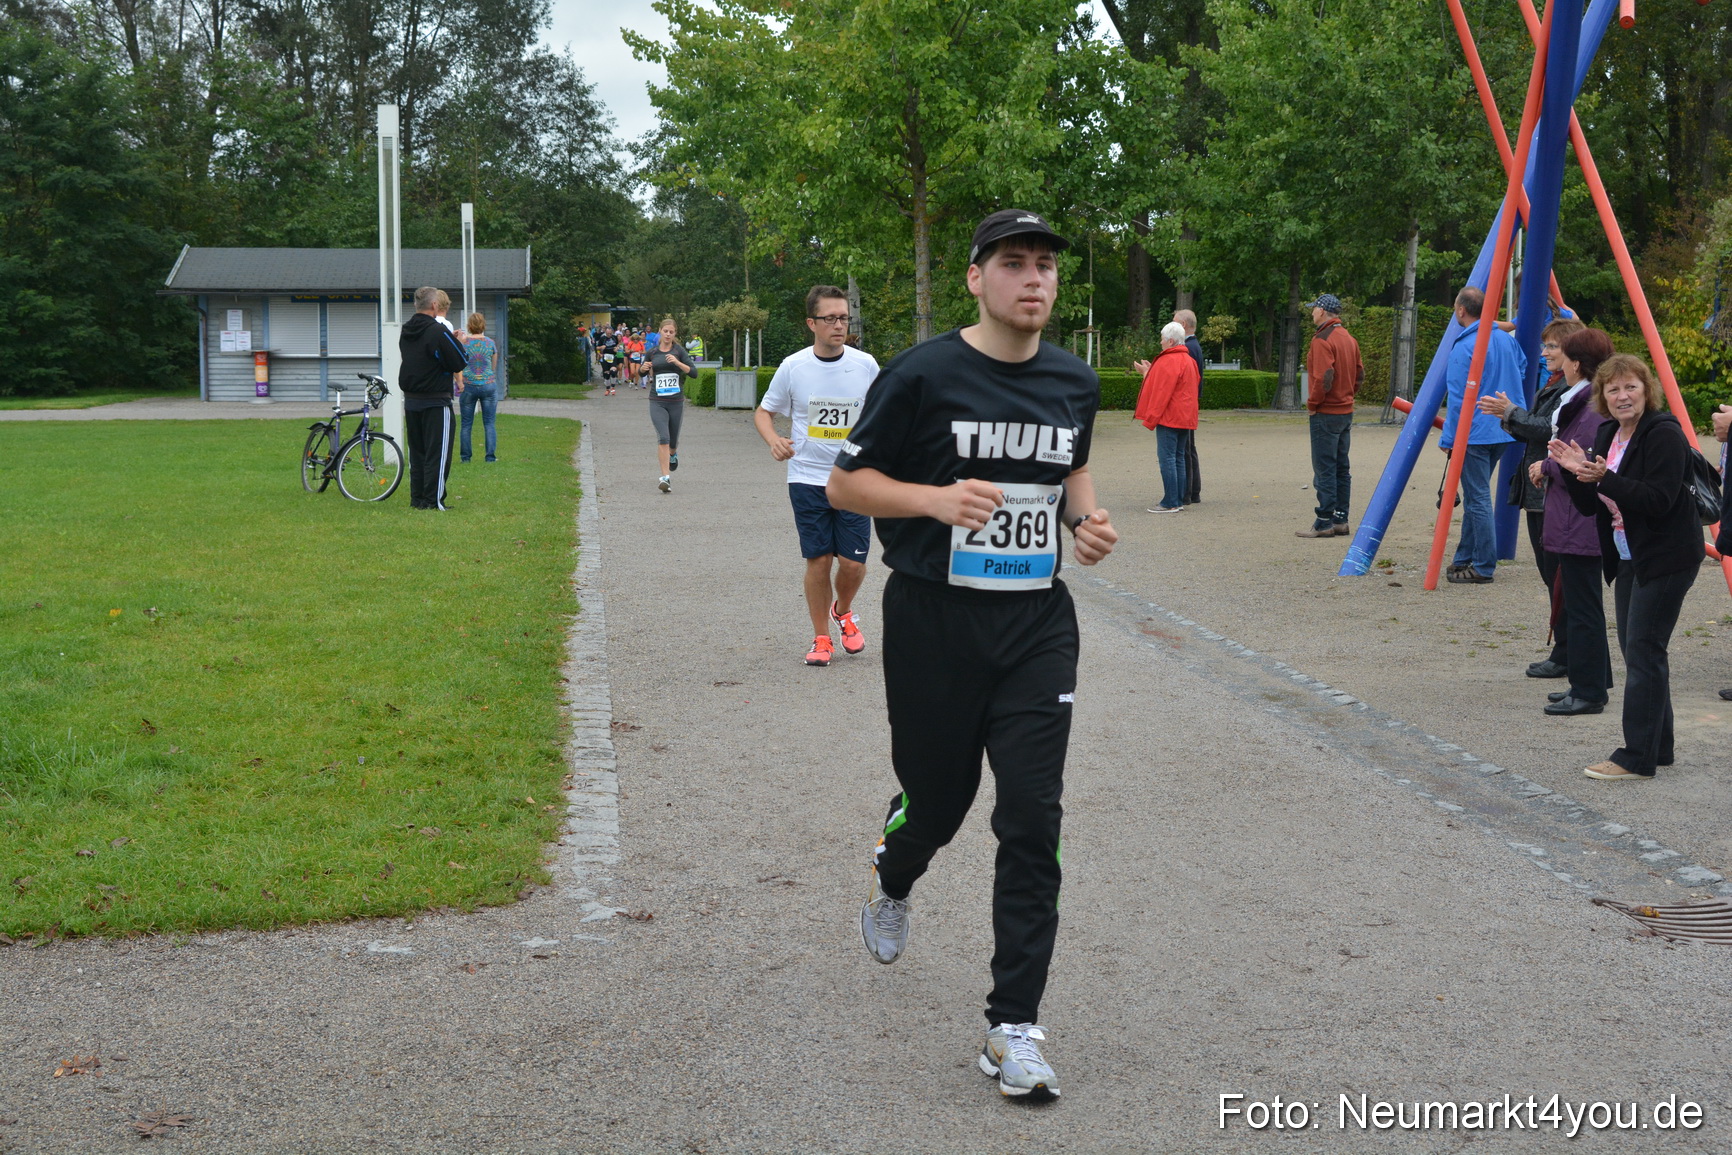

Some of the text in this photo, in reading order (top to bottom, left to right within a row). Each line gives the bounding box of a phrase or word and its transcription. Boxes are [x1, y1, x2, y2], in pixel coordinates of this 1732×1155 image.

[658, 378, 676, 387] 2122
[818, 408, 849, 426] 231
[951, 421, 1074, 465] THULE
[1041, 452, 1071, 462] SWEDEN
[1002, 494, 1044, 505] Neumarkt
[984, 559, 1031, 575] Patrick
